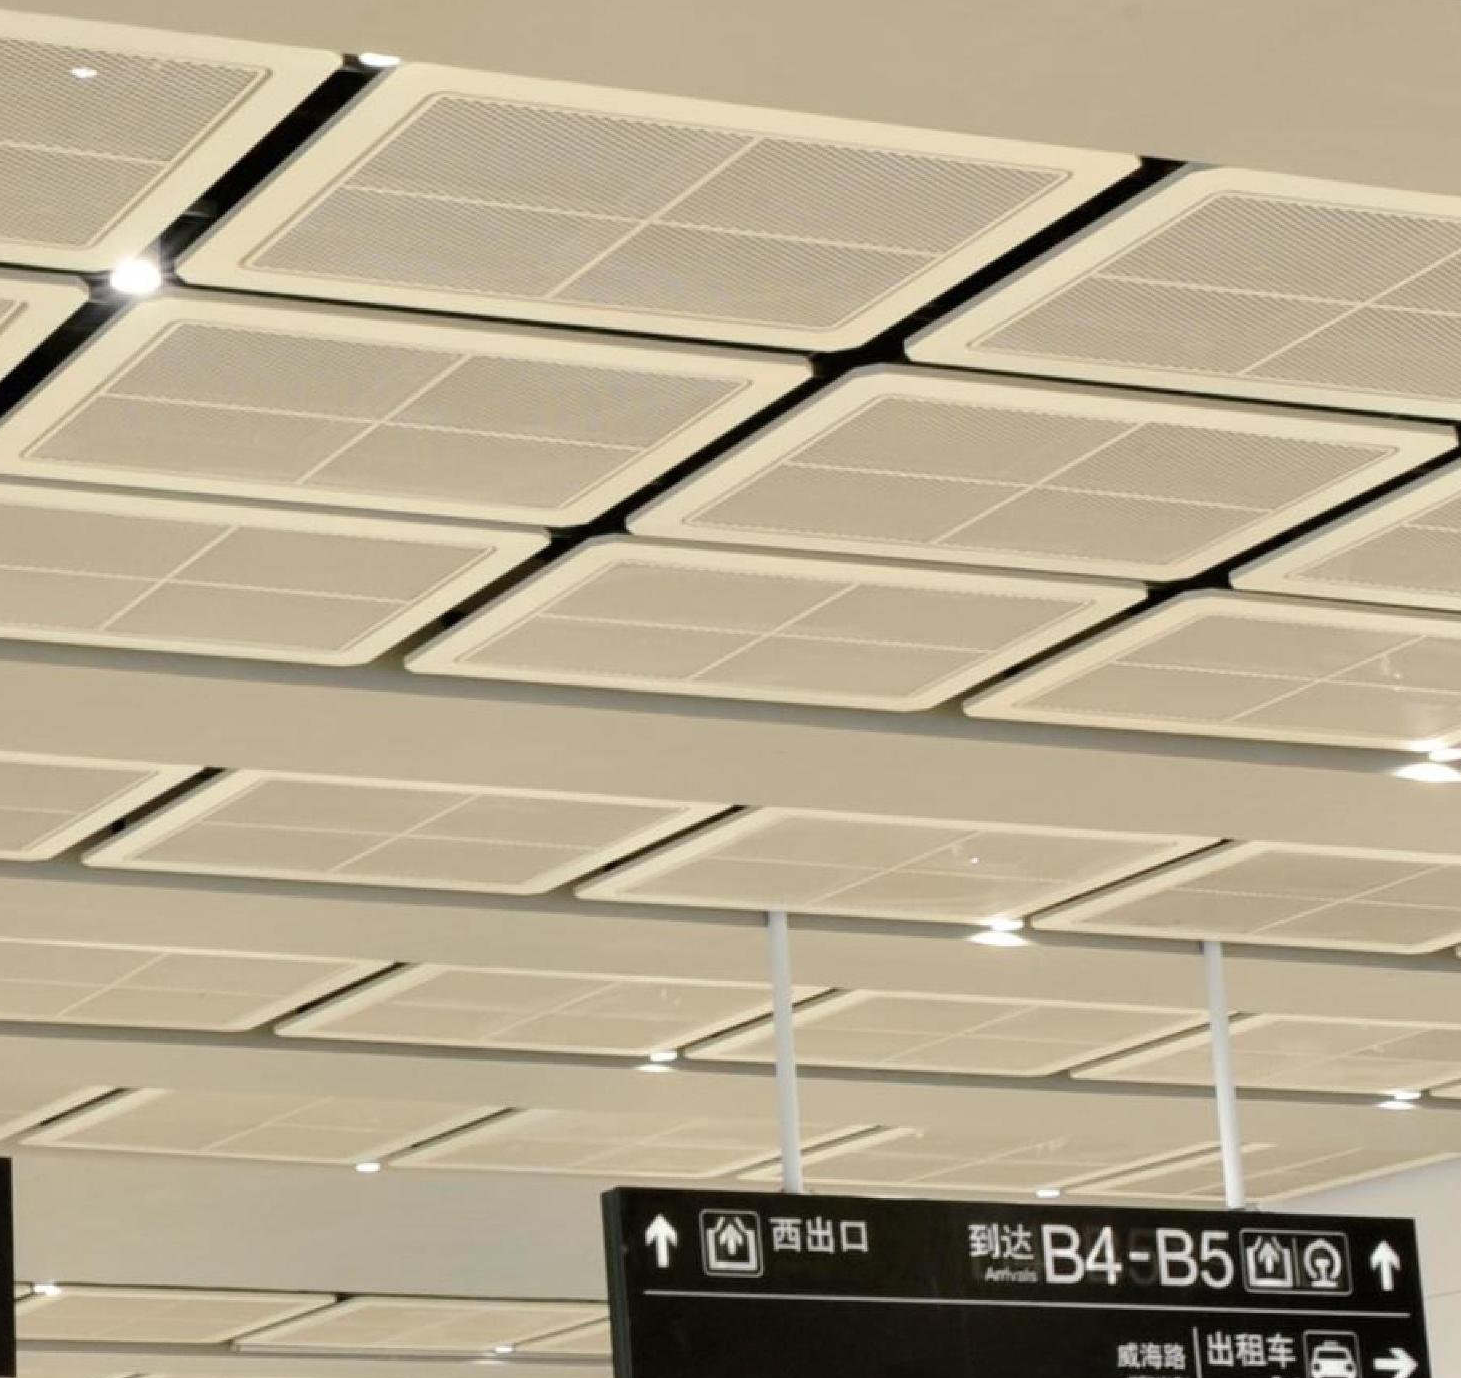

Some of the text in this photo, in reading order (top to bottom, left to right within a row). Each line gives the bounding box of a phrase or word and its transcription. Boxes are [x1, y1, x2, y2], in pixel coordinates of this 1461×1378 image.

[769, 1215, 870, 1254] 西出口
[968, 1222, 1235, 1289] 到达 B4-B5
[1206, 1330, 1297, 1370] 出租车
